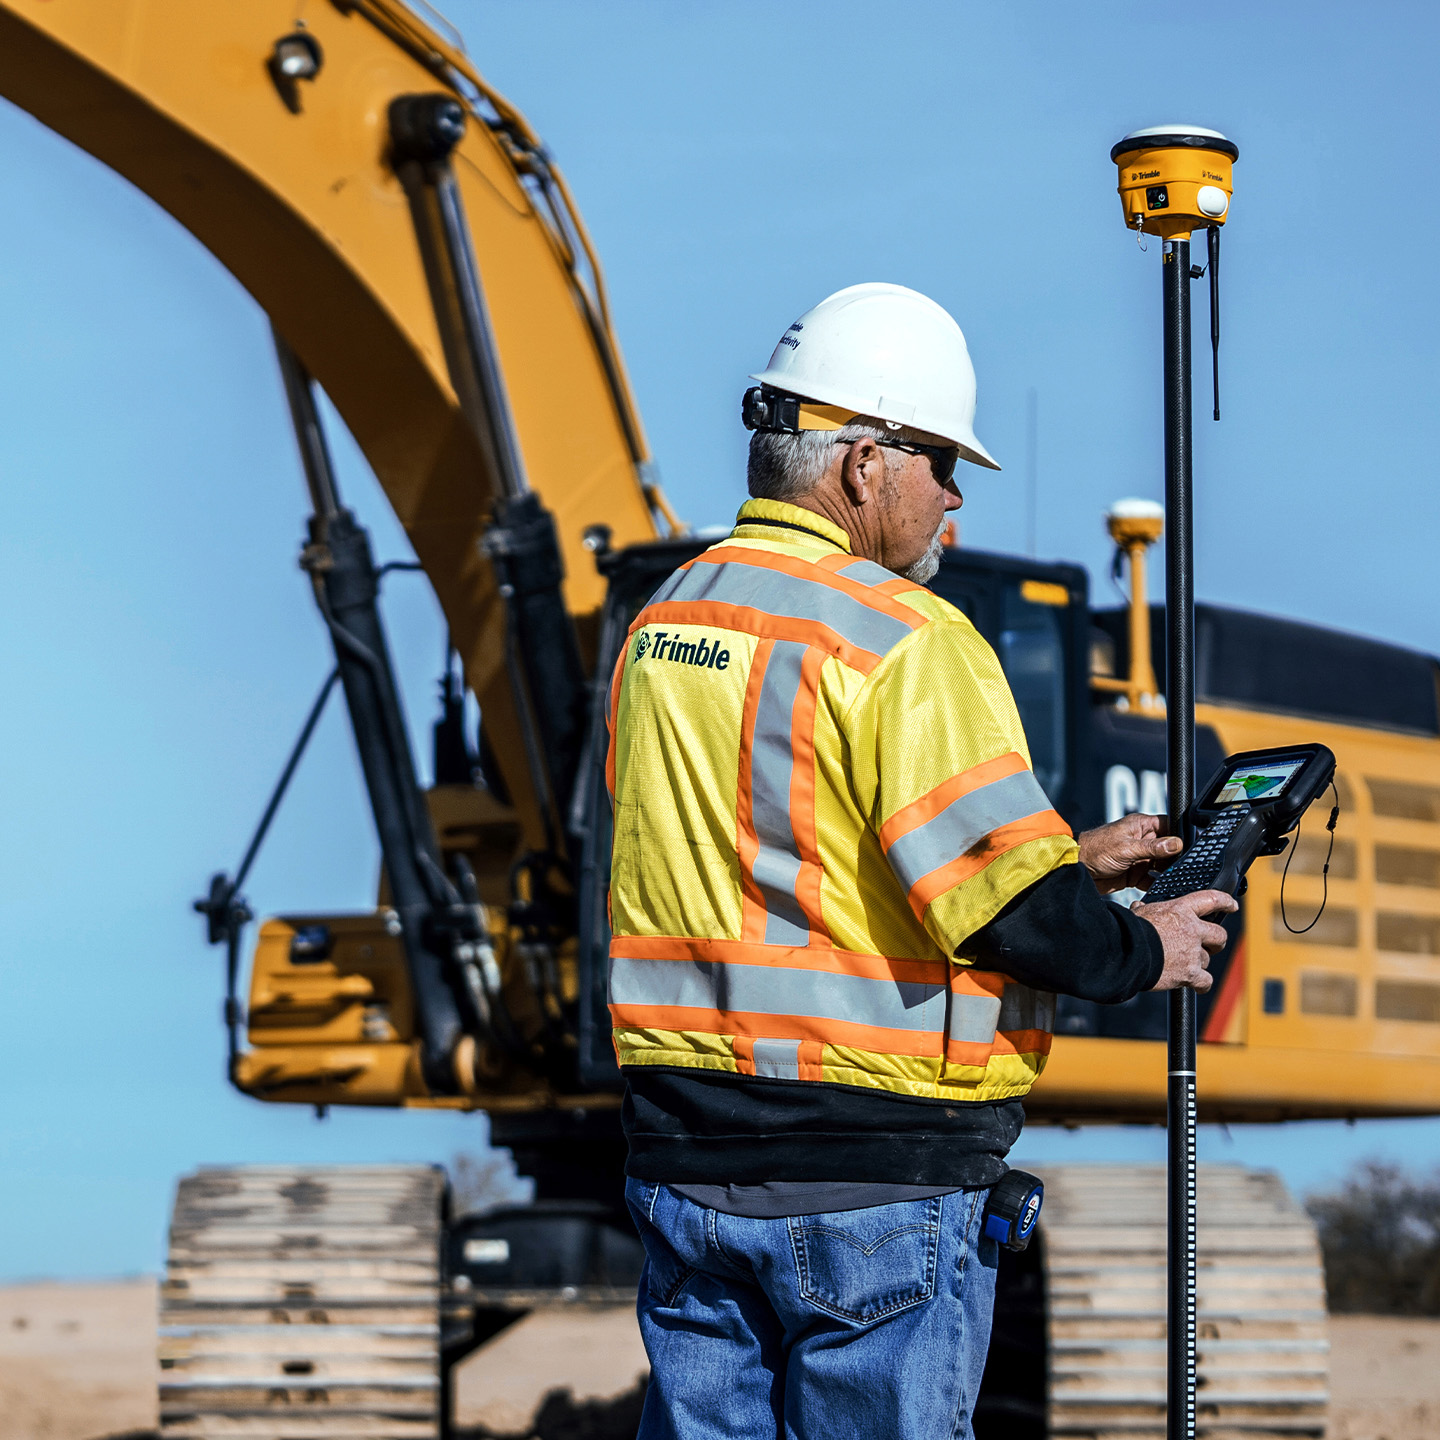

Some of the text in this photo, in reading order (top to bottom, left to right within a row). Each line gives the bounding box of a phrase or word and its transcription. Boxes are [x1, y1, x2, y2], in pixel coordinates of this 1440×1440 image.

[1138, 170, 1160, 180] Trimble
[1207, 172, 1223, 182] Trimble
[651, 632, 730, 671] Trimble
[1105, 764, 1168, 822] CA
